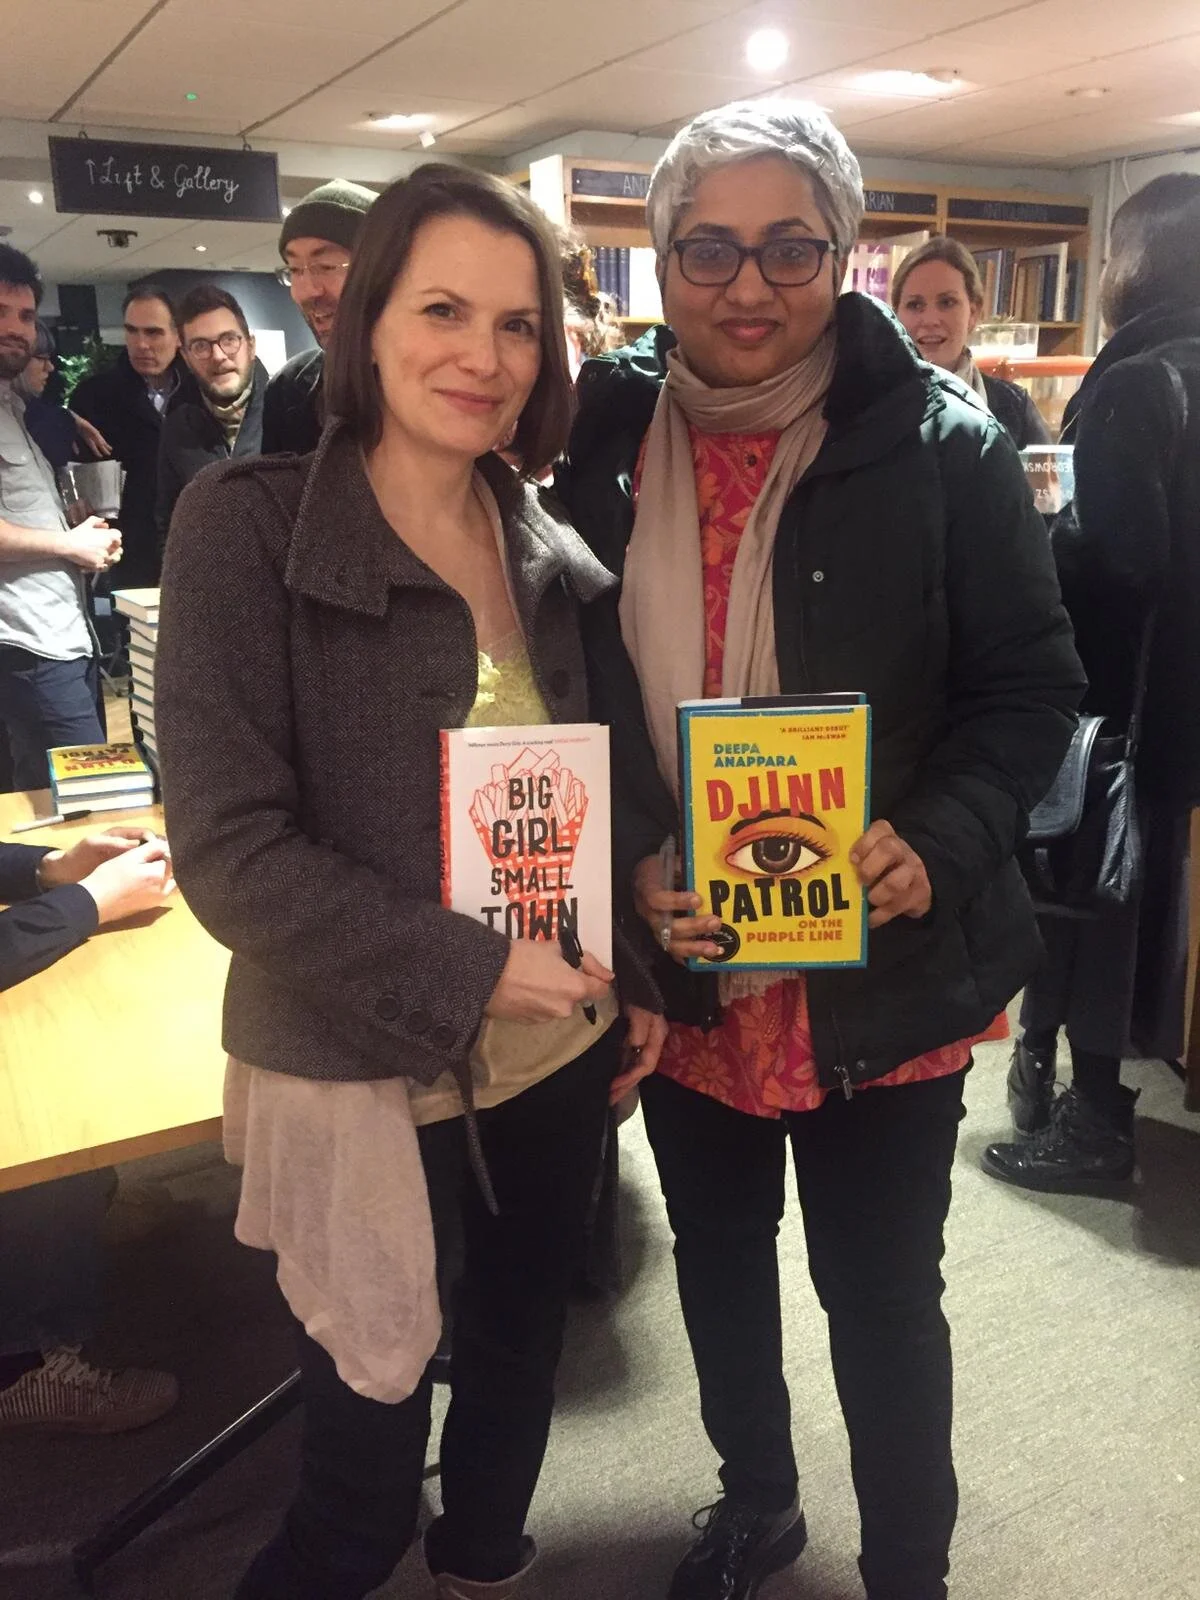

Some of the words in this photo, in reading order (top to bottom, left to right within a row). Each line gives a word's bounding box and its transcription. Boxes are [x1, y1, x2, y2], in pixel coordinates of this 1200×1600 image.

[100, 156, 142, 194] Lift
[150, 165, 165, 188] &
[174, 164, 239, 203] Gallery
[713, 743, 760, 755] DEEPA
[714, 755, 797, 768] ANAPPARA
[508, 775, 553, 811] BIG
[706, 766, 846, 821] DJINN
[492, 816, 573, 858] GIRL
[490, 864, 573, 895] SMALL
[709, 873, 849, 923] PATROL
[481, 897, 578, 940] TOWN
[746, 931, 804, 943] PURPLE
[809, 930, 843, 941] LINE
[799, 920, 817, 929] ON
[821, 919, 843, 928] THE
